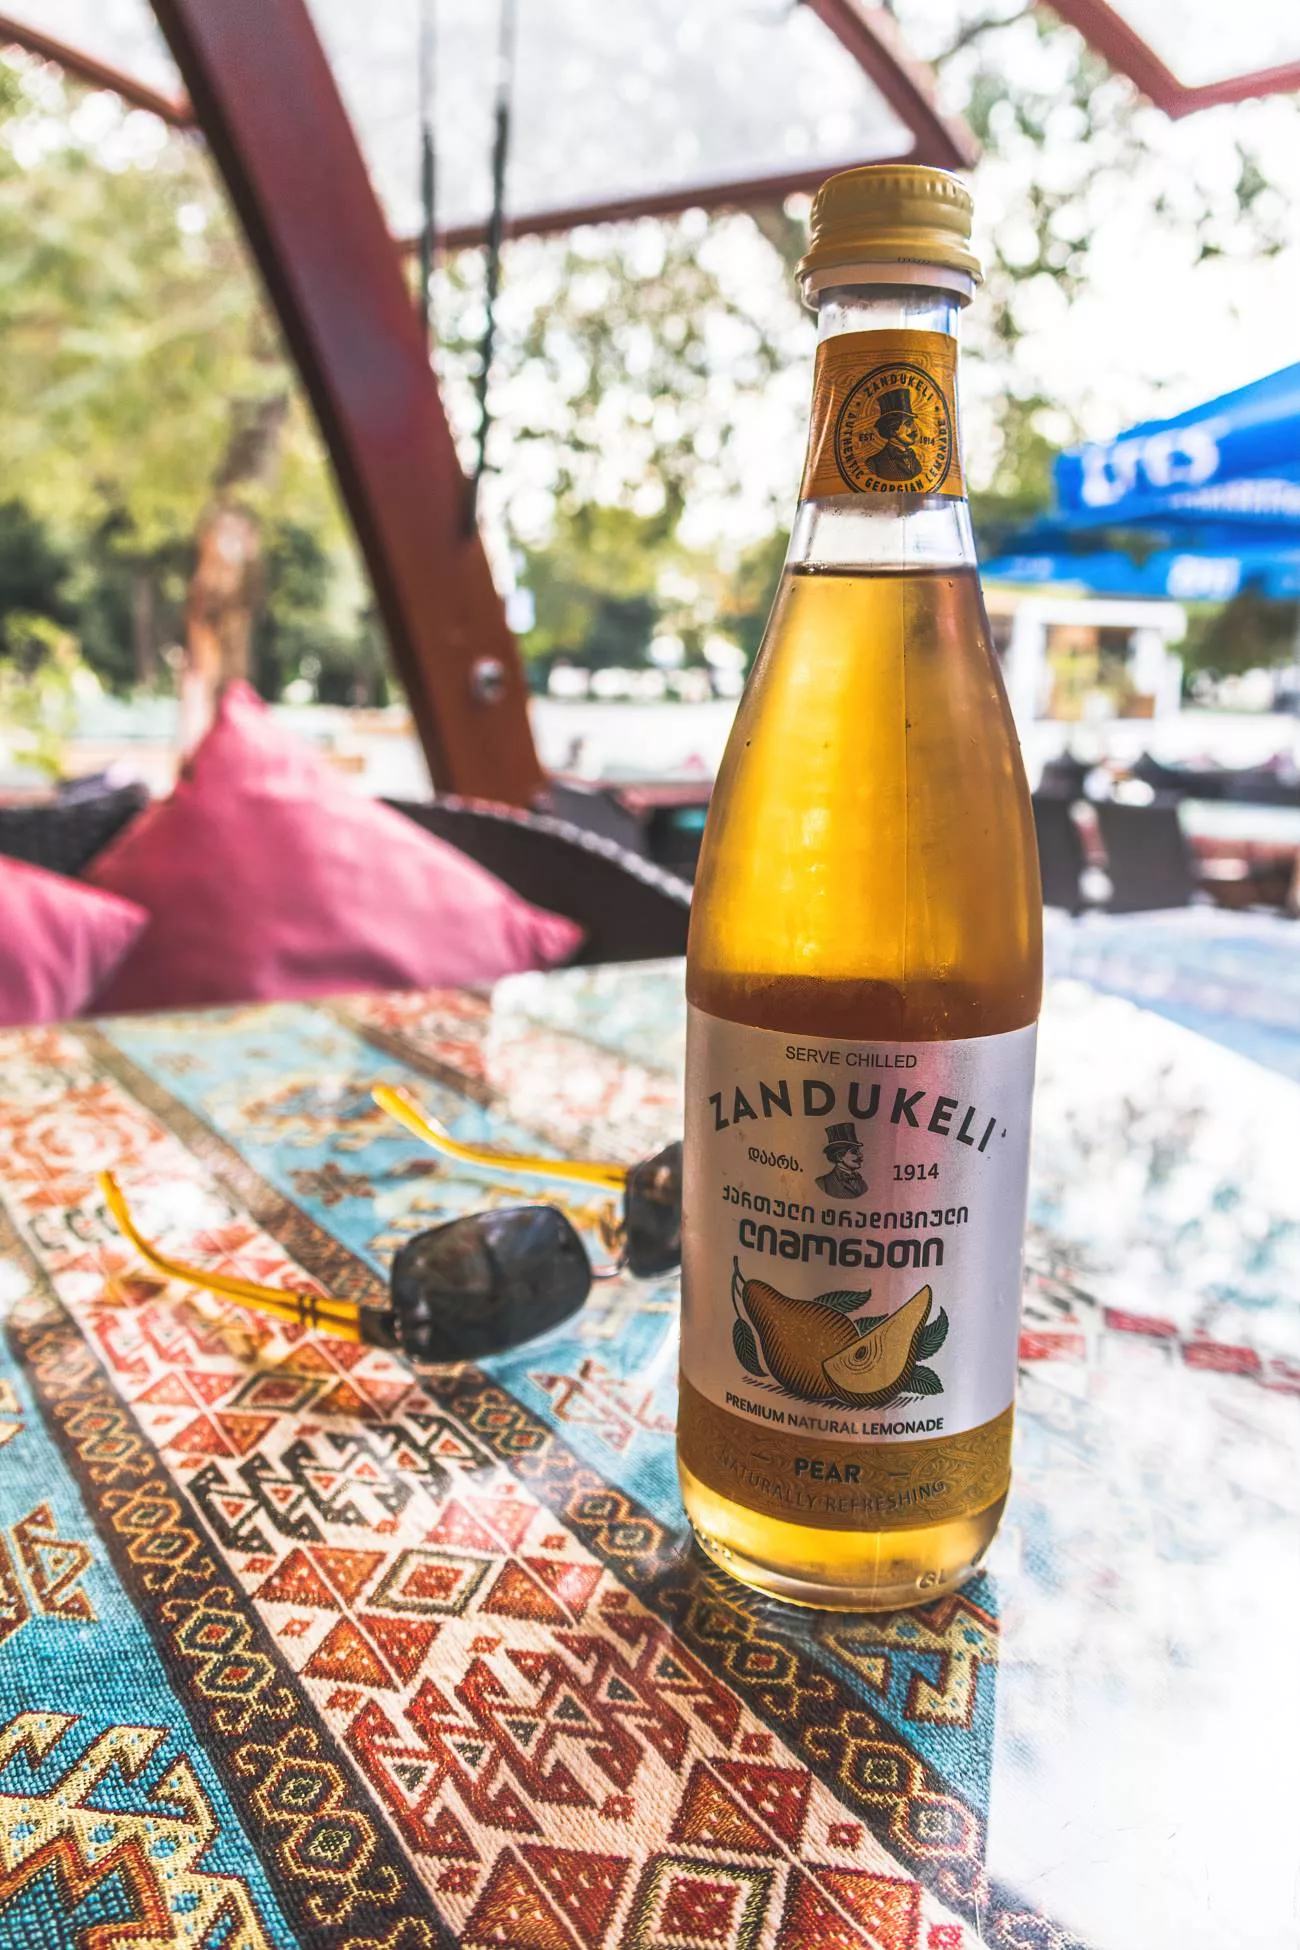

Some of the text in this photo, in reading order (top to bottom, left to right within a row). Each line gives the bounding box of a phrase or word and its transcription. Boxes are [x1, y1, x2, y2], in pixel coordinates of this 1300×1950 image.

[864, 374, 933, 401] ZANDUKELI
[842, 413, 947, 493] AUTHENTIC GEORGIAN LEMONADE
[858, 433, 875, 442] EST.
[919, 436, 935, 446] 1914
[785, 1046, 918, 1069] SERVE CHILLED
[709, 1080, 997, 1153] ZANDUKELI
[892, 1163, 939, 1182] 1914
[722, 1184, 815, 1224] ქართული
[738, 1218, 944, 1269] ლიმონათი
[725, 1391, 945, 1436] PREMIUM NATURAL LEMONADE
[720, 1449, 946, 1514] NATURALLY REFRESHING
[794, 1456, 862, 1484] PEAR
